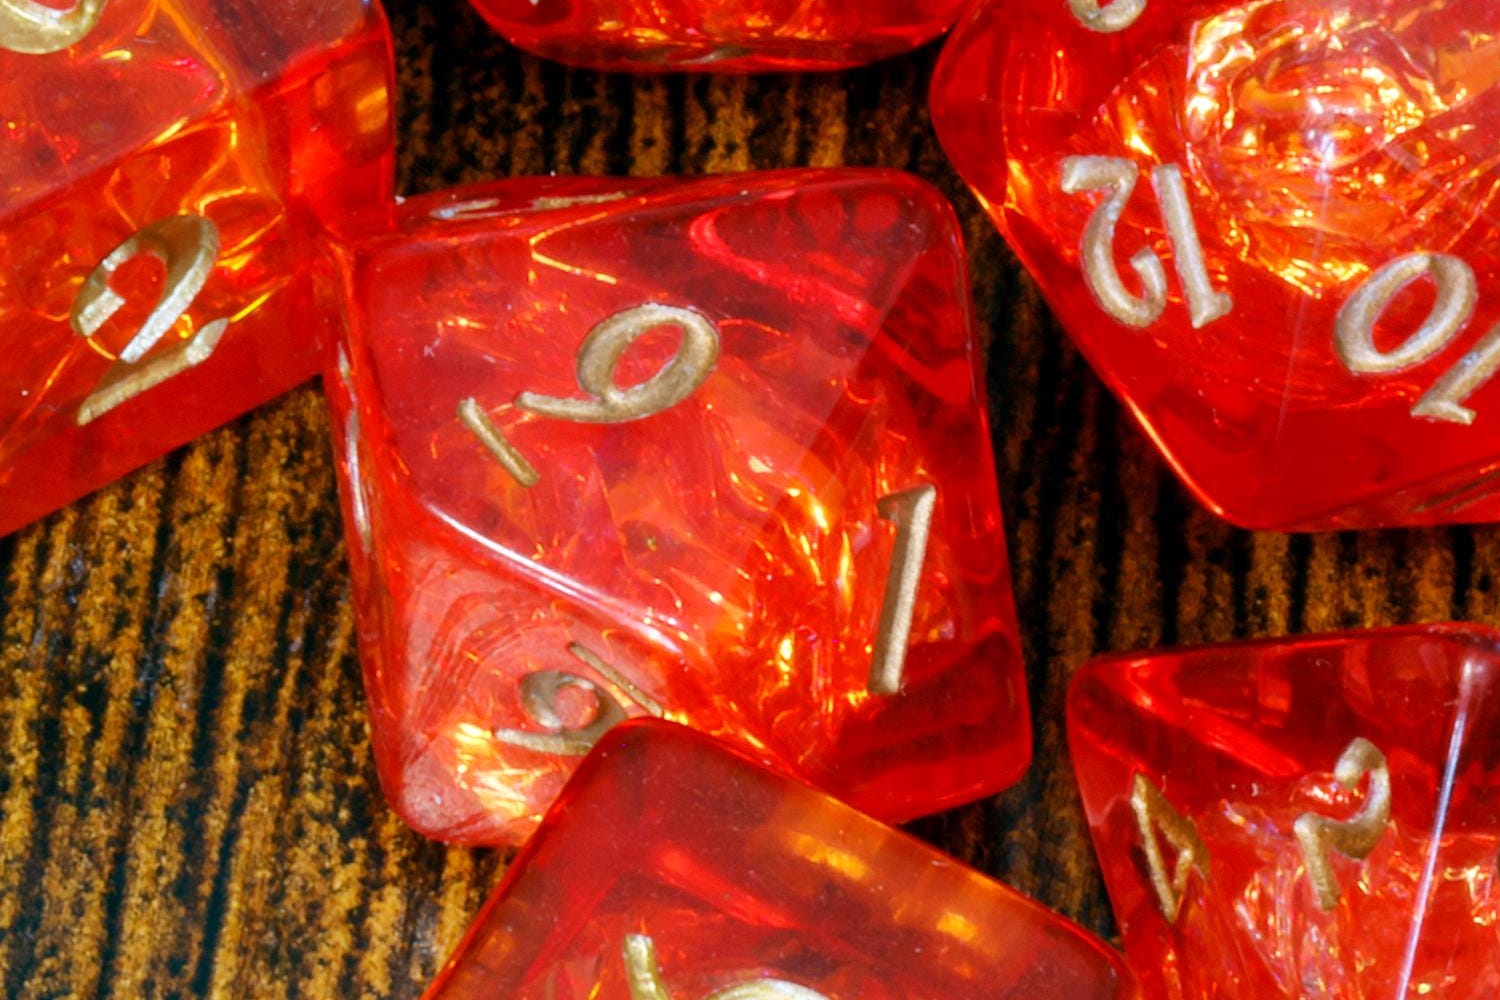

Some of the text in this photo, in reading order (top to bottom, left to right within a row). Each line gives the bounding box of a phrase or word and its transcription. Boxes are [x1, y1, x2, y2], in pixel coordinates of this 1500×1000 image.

[71, 215, 229, 427] 2
[1060, 155, 1232, 329] 12
[878, 483, 937, 696] 1
[1294, 736, 1391, 911] 2
